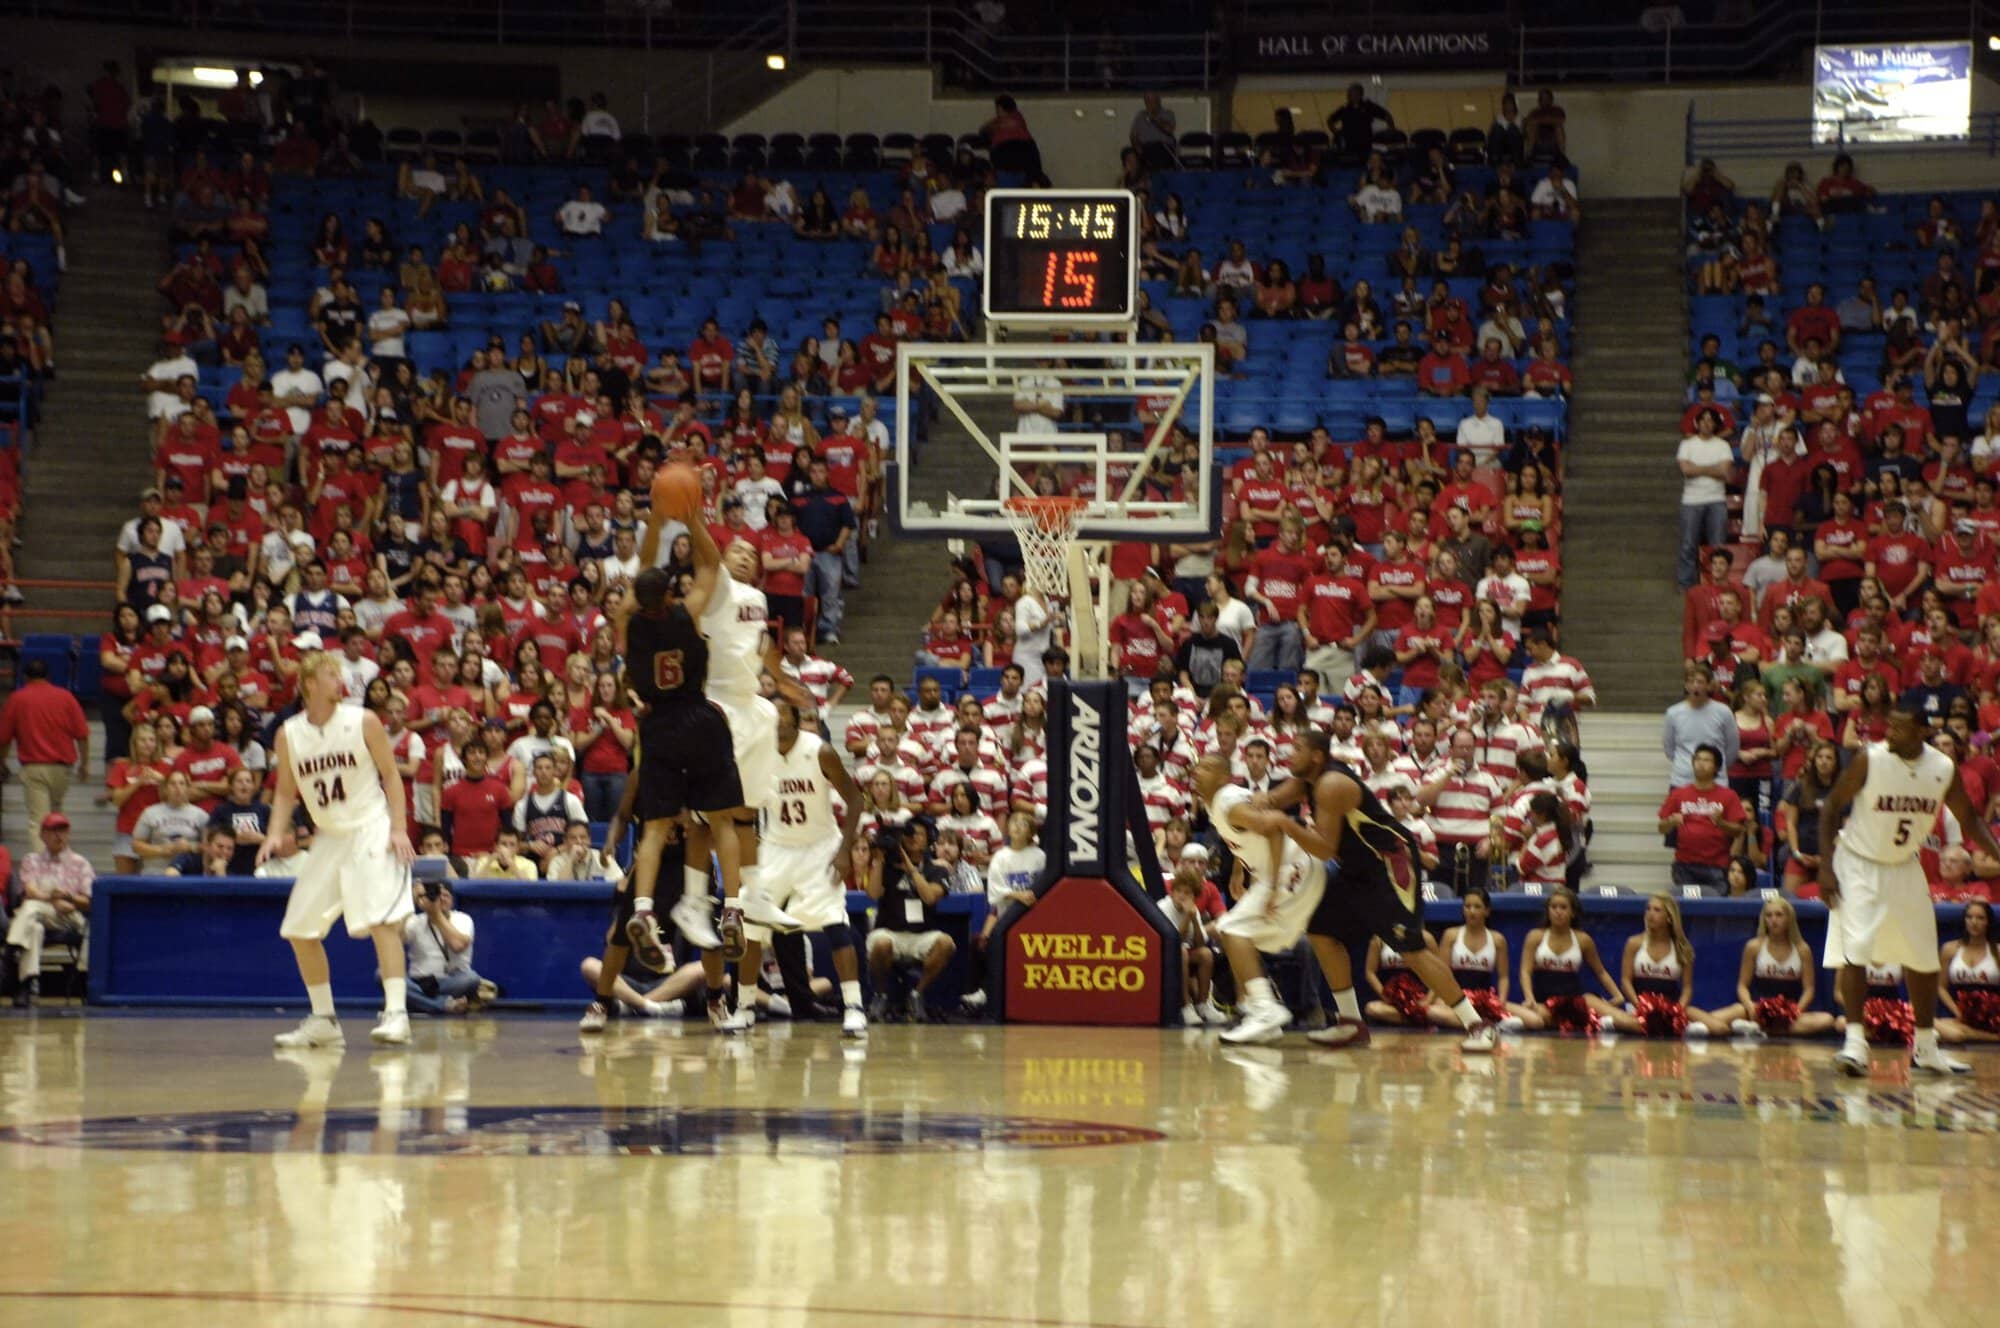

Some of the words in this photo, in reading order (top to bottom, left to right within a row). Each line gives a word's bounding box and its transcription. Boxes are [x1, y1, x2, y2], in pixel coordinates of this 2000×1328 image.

[1258, 36, 1313, 56] HALL
[1321, 35, 1349, 57] OF
[1357, 33, 1490, 56] CHAMPIONS
[1852, 49, 1879, 67] The
[1016, 204, 1117, 239] 15:45
[1043, 251, 1098, 307] 15
[297, 750, 358, 779] ARIZONA
[313, 775, 347, 808] 34
[1069, 692, 1101, 866] ARIZONA
[778, 800, 808, 826] 43
[1874, 794, 1938, 815] ARIZONA
[1893, 819, 1913, 846] 5
[1019, 933, 1147, 961] WELLS
[1023, 964, 1145, 992] FARGO
